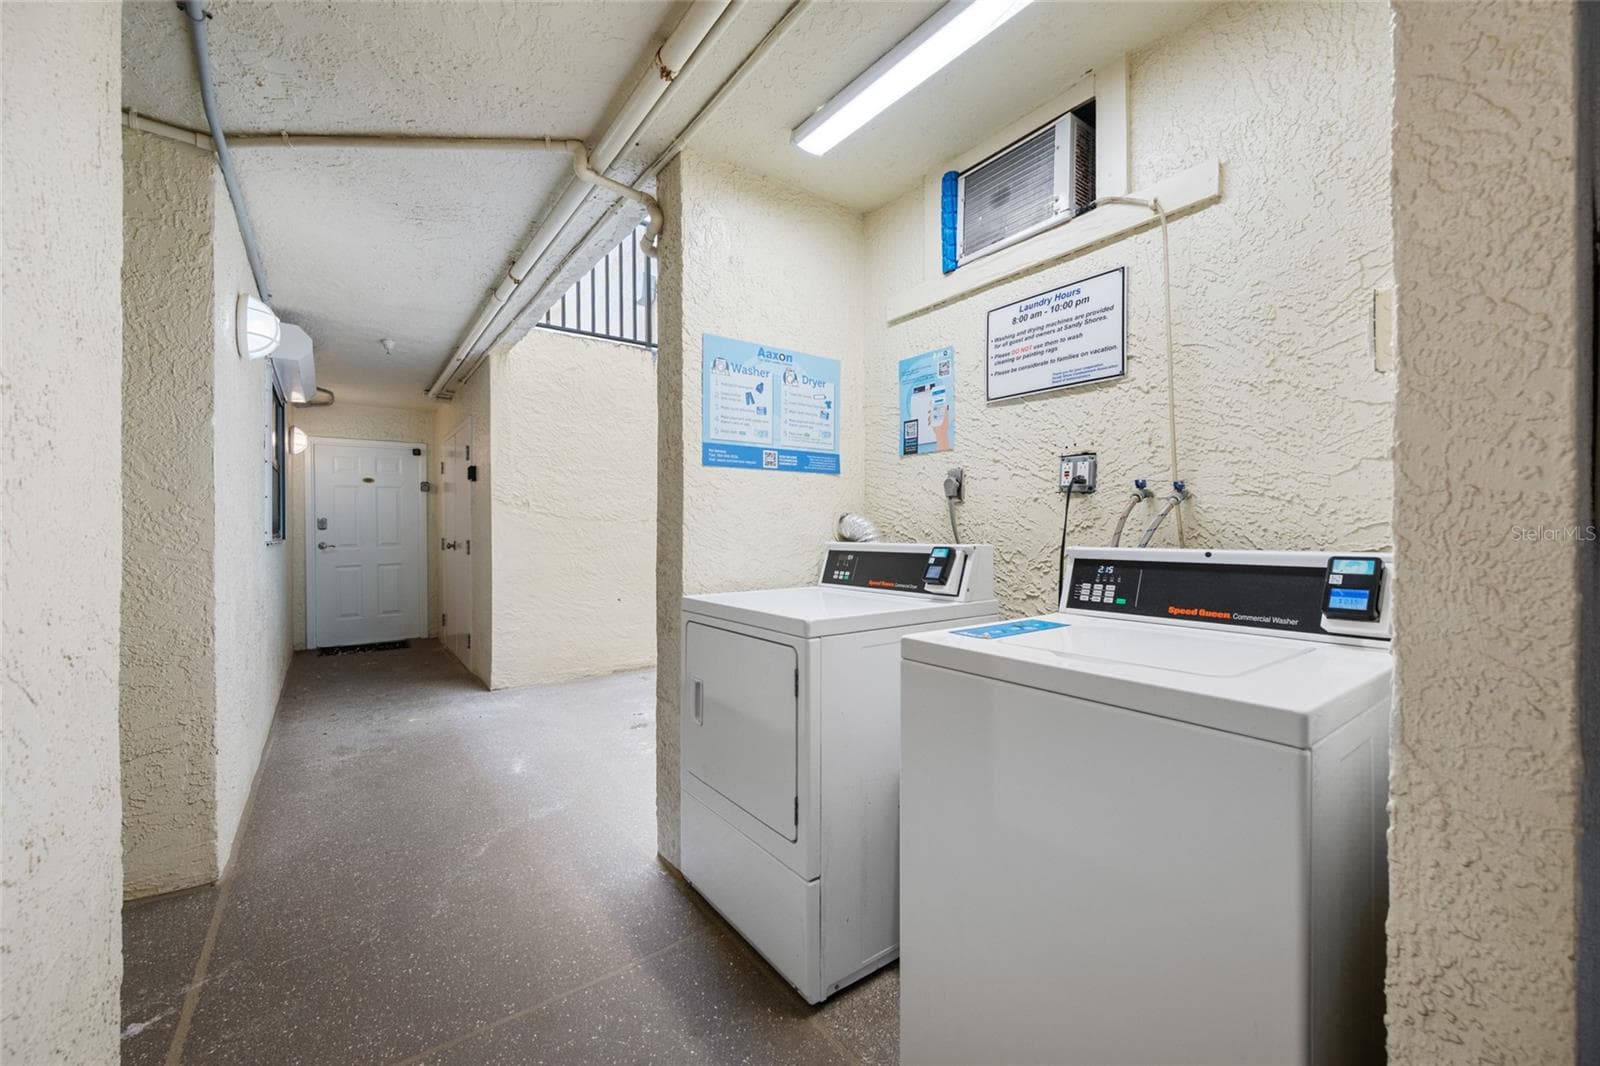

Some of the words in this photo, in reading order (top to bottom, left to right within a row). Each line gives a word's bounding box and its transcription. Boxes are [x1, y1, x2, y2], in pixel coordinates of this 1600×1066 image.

[1012, 313, 1029, 325] 8:00
[1030, 310, 1043, 320] am
[1051, 299, 1074, 313] 10:00
[1075, 296, 1090, 308] pm
[1019, 298, 1053, 312] Laundry
[1055, 288, 1081, 301] Hours
[994, 333, 1015, 343] Washing
[1016, 329, 1026, 337] and
[1045, 318, 1073, 328] machines
[1086, 305, 1115, 318] provided
[1024, 333, 1035, 341] and
[1035, 328, 1056, 338] owners
[1063, 320, 1083, 331] Sandy
[757, 346, 793, 364] Aaxon
[994, 352, 1010, 360] Please
[1044, 338, 1059, 347] them
[1067, 332, 1083, 341] wash
[1022, 350, 1045, 360] painting
[1045, 346, 1058, 354] rags
[731, 362, 770, 379] Washer
[994, 369, 1010, 377] Please
[1080, 350, 1089, 358] on
[802, 374, 827, 389] Dryer
[1168, 606, 1198, 616] Speed
[1199, 609, 1231, 619] Queen
[1232, 613, 1272, 623] Commercial
[1272, 617, 1299, 625] Washer
